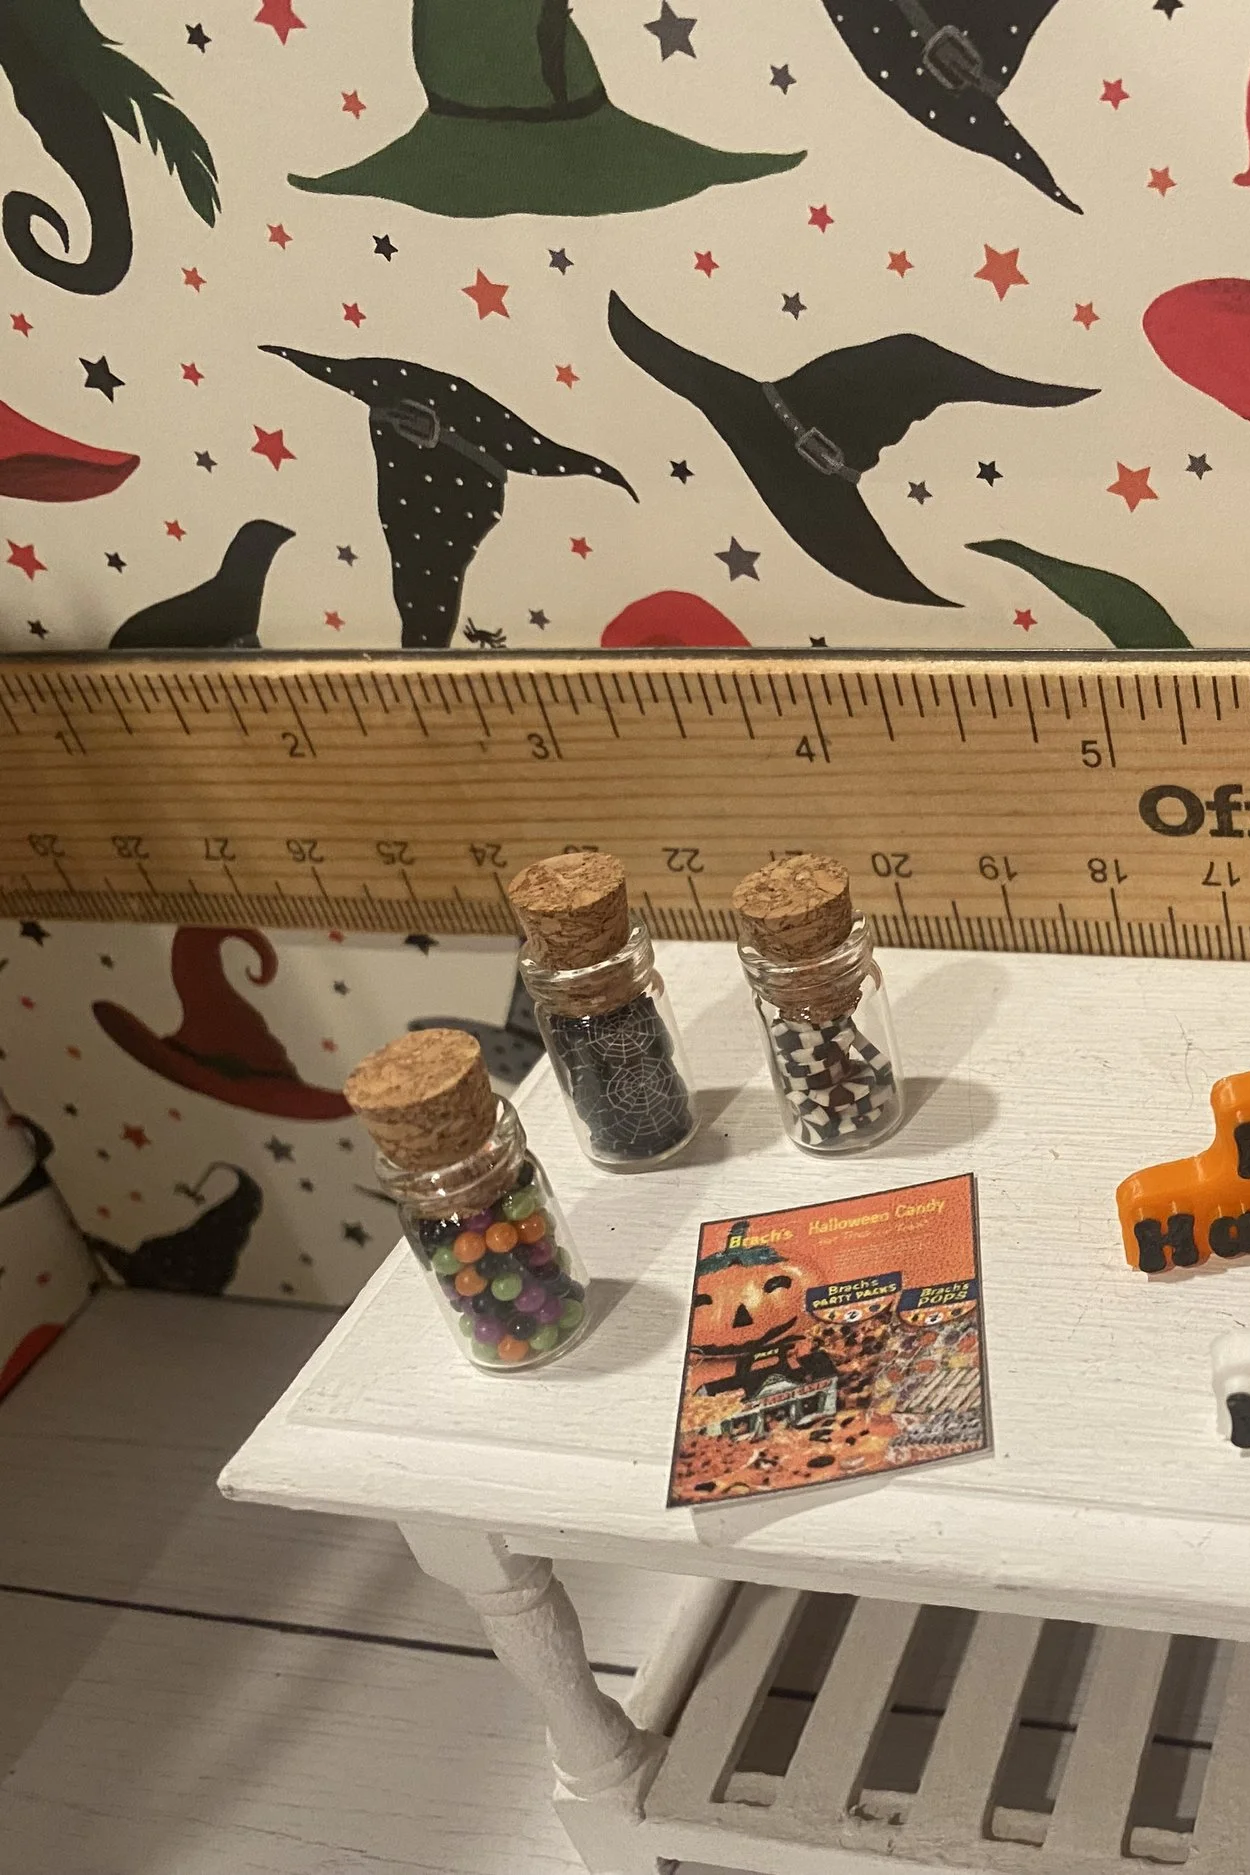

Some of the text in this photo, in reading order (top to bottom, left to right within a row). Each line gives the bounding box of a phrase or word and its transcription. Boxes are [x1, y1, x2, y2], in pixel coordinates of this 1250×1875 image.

[54, 731, 73, 756] 1
[281, 733, 306, 759] 2
[526, 733, 551, 760] 3
[795, 735, 816, 763] 4
[1080, 740, 1102, 768] 5
[203, 837, 237, 861] 27
[284, 839, 325, 864] 26
[375, 840, 416, 866] 25
[469, 843, 508, 869] 24
[662, 847, 705, 874] 22
[871, 853, 913, 879] 20
[979, 855, 1018, 881] 19
[1087, 858, 1128, 884] 18
[1201, 861, 1241, 888] 17
[728, 1228, 794, 1249] Brach's
[808, 1211, 889, 1235] Halloween
[895, 1199, 945, 1218] Candy
[812, 1283, 898, 1308] PARTY PACKS
[828, 1278, 879, 1296] Brach's
[917, 1291, 969, 1308] POPS
[920, 1282, 970, 1299] Brach's
